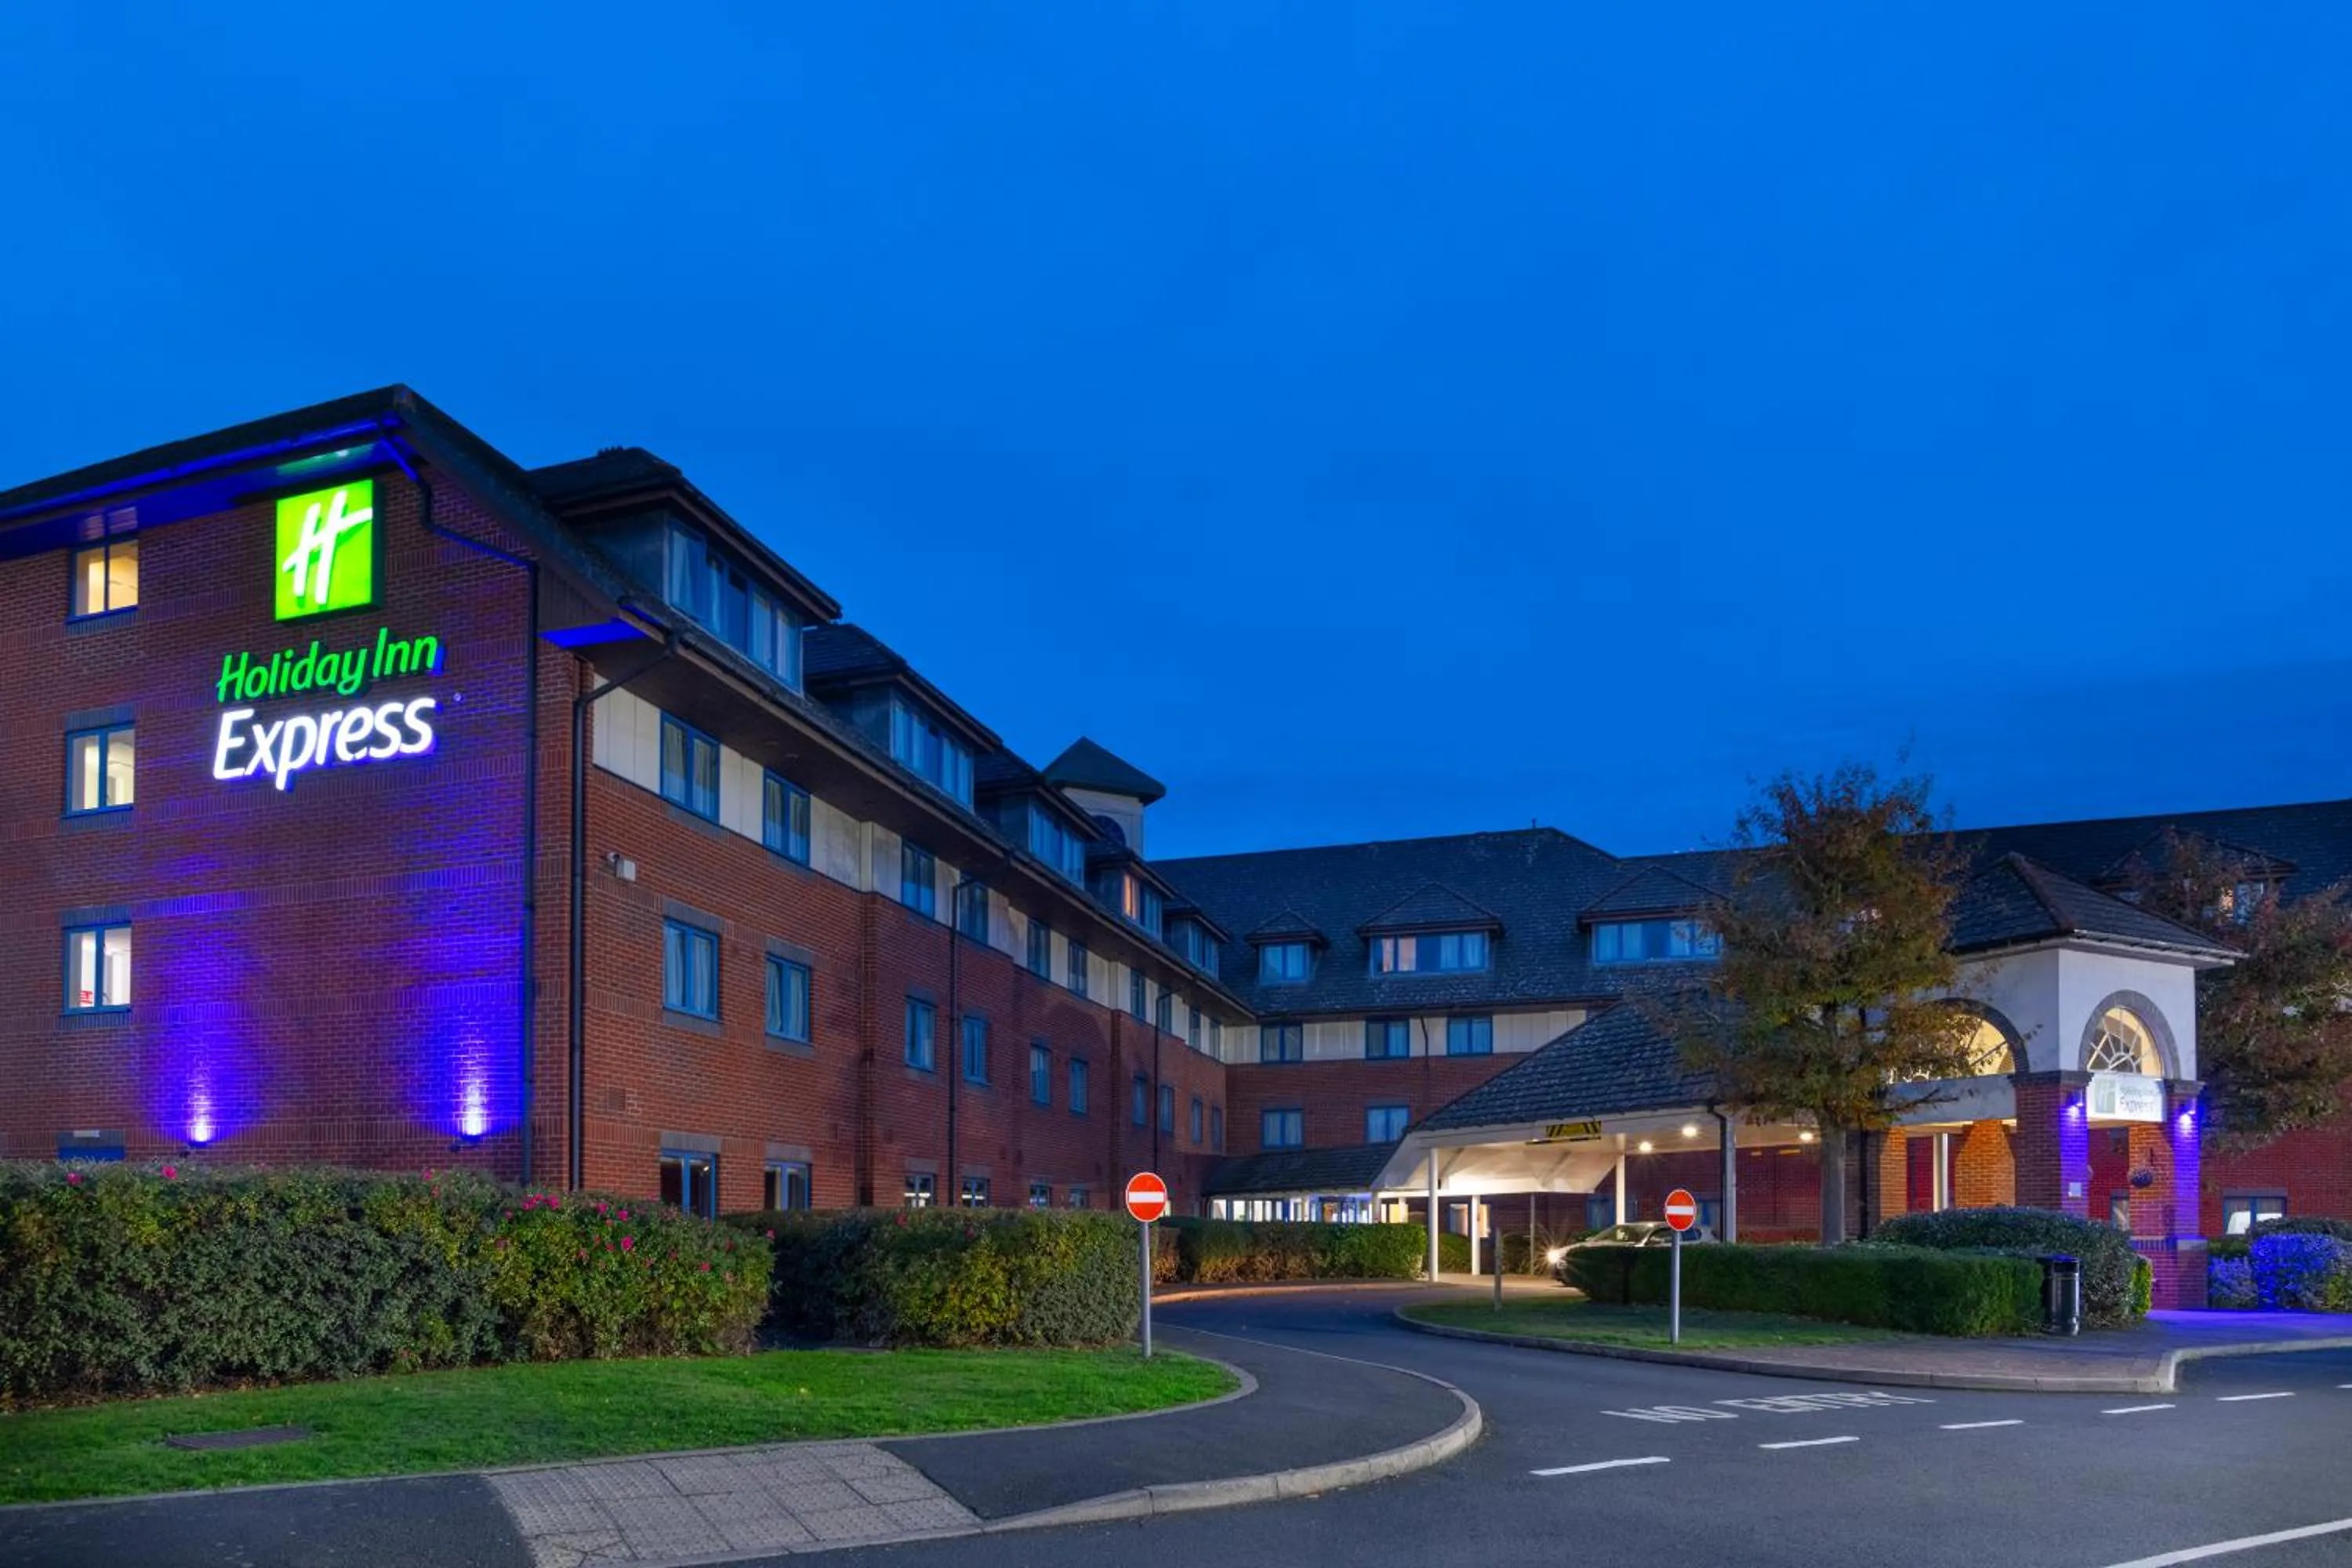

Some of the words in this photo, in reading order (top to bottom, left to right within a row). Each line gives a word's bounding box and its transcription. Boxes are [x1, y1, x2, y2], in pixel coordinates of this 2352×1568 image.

[216, 641, 367, 702] Holiday
[372, 627, 437, 677] Inn
[212, 697, 436, 791] Express
[1600, 1405, 1739, 1424] NO
[1712, 1391, 1936, 1414] ENTRY
